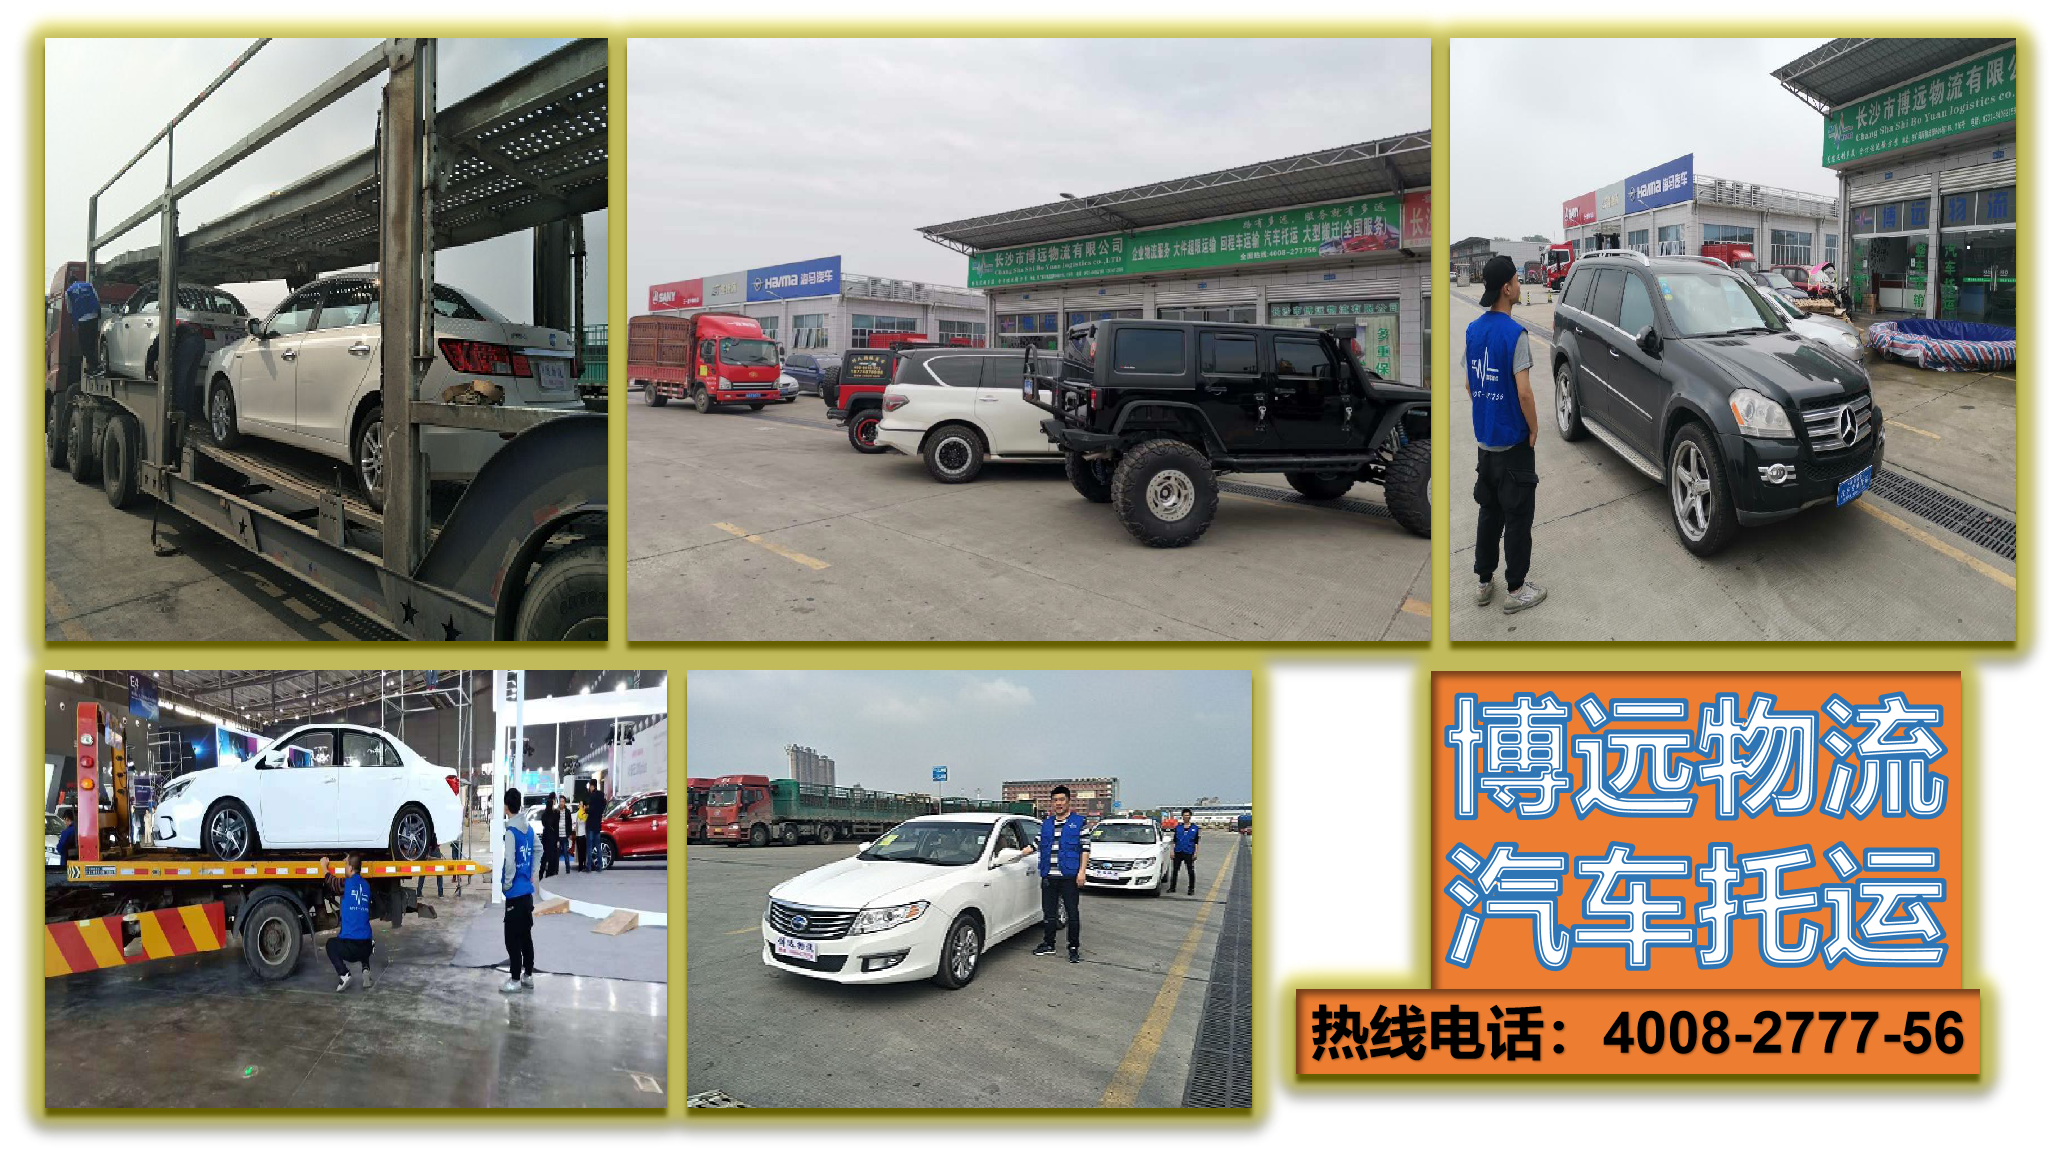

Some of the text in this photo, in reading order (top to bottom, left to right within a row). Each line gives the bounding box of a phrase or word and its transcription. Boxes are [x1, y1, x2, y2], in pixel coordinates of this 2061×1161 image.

[1880, 125, 1894, 135] Sha
[1895, 119, 1909, 130] Shi
[1911, 117, 1922, 127] Bo
[1924, 109, 1948, 123] Yuan
[1949, 95, 1996, 115] logistics
[1263, 226, 1298, 247] 汽车托运
[994, 237, 1123, 268] 长沙市博远物流有限公司
[130, 675, 139, 689] E4
